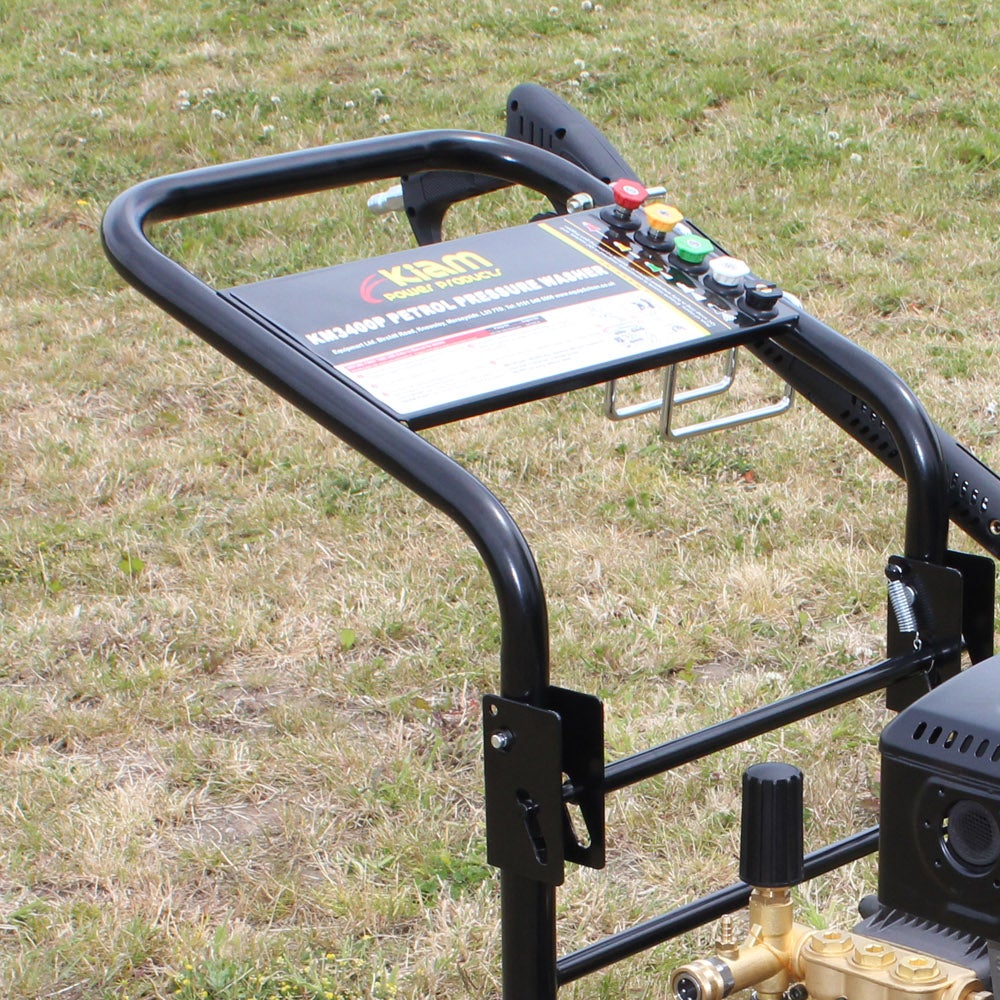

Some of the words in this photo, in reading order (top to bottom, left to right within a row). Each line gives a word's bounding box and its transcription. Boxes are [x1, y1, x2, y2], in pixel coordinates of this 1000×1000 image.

[386, 299, 457, 324] PETROL
[452, 279, 543, 307] PRESSURE
[537, 265, 609, 288] WASHER
